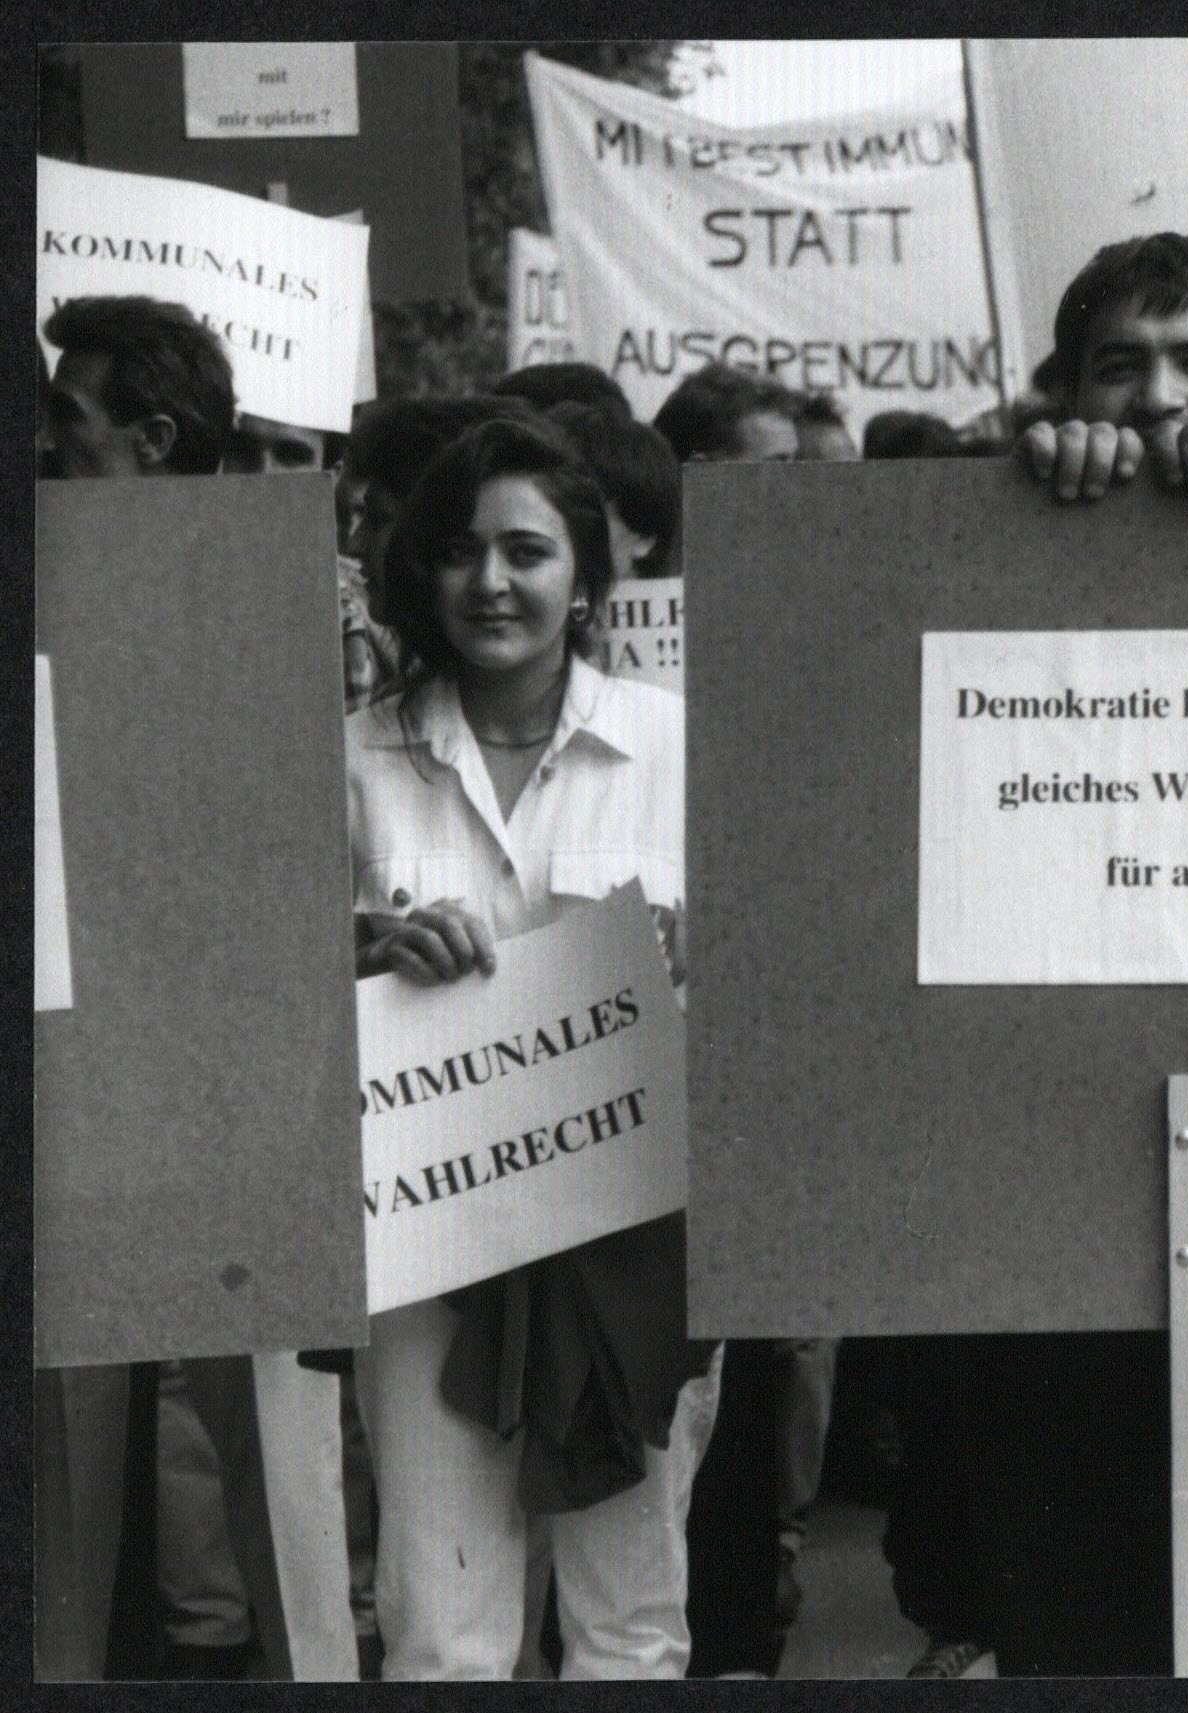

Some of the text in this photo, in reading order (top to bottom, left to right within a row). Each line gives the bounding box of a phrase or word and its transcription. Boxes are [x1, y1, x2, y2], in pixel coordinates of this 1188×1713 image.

[258, 67, 288, 84] mit
[218, 110, 248, 126] mir
[704, 207, 911, 267] STATT
[43, 229, 319, 302] KOMMUNALES
[956, 687, 1171, 719] Demokratie
[998, 773, 1140, 810] gleiches
[1105, 857, 1159, 888] für
[361, 989, 641, 1120] MMUNALES
